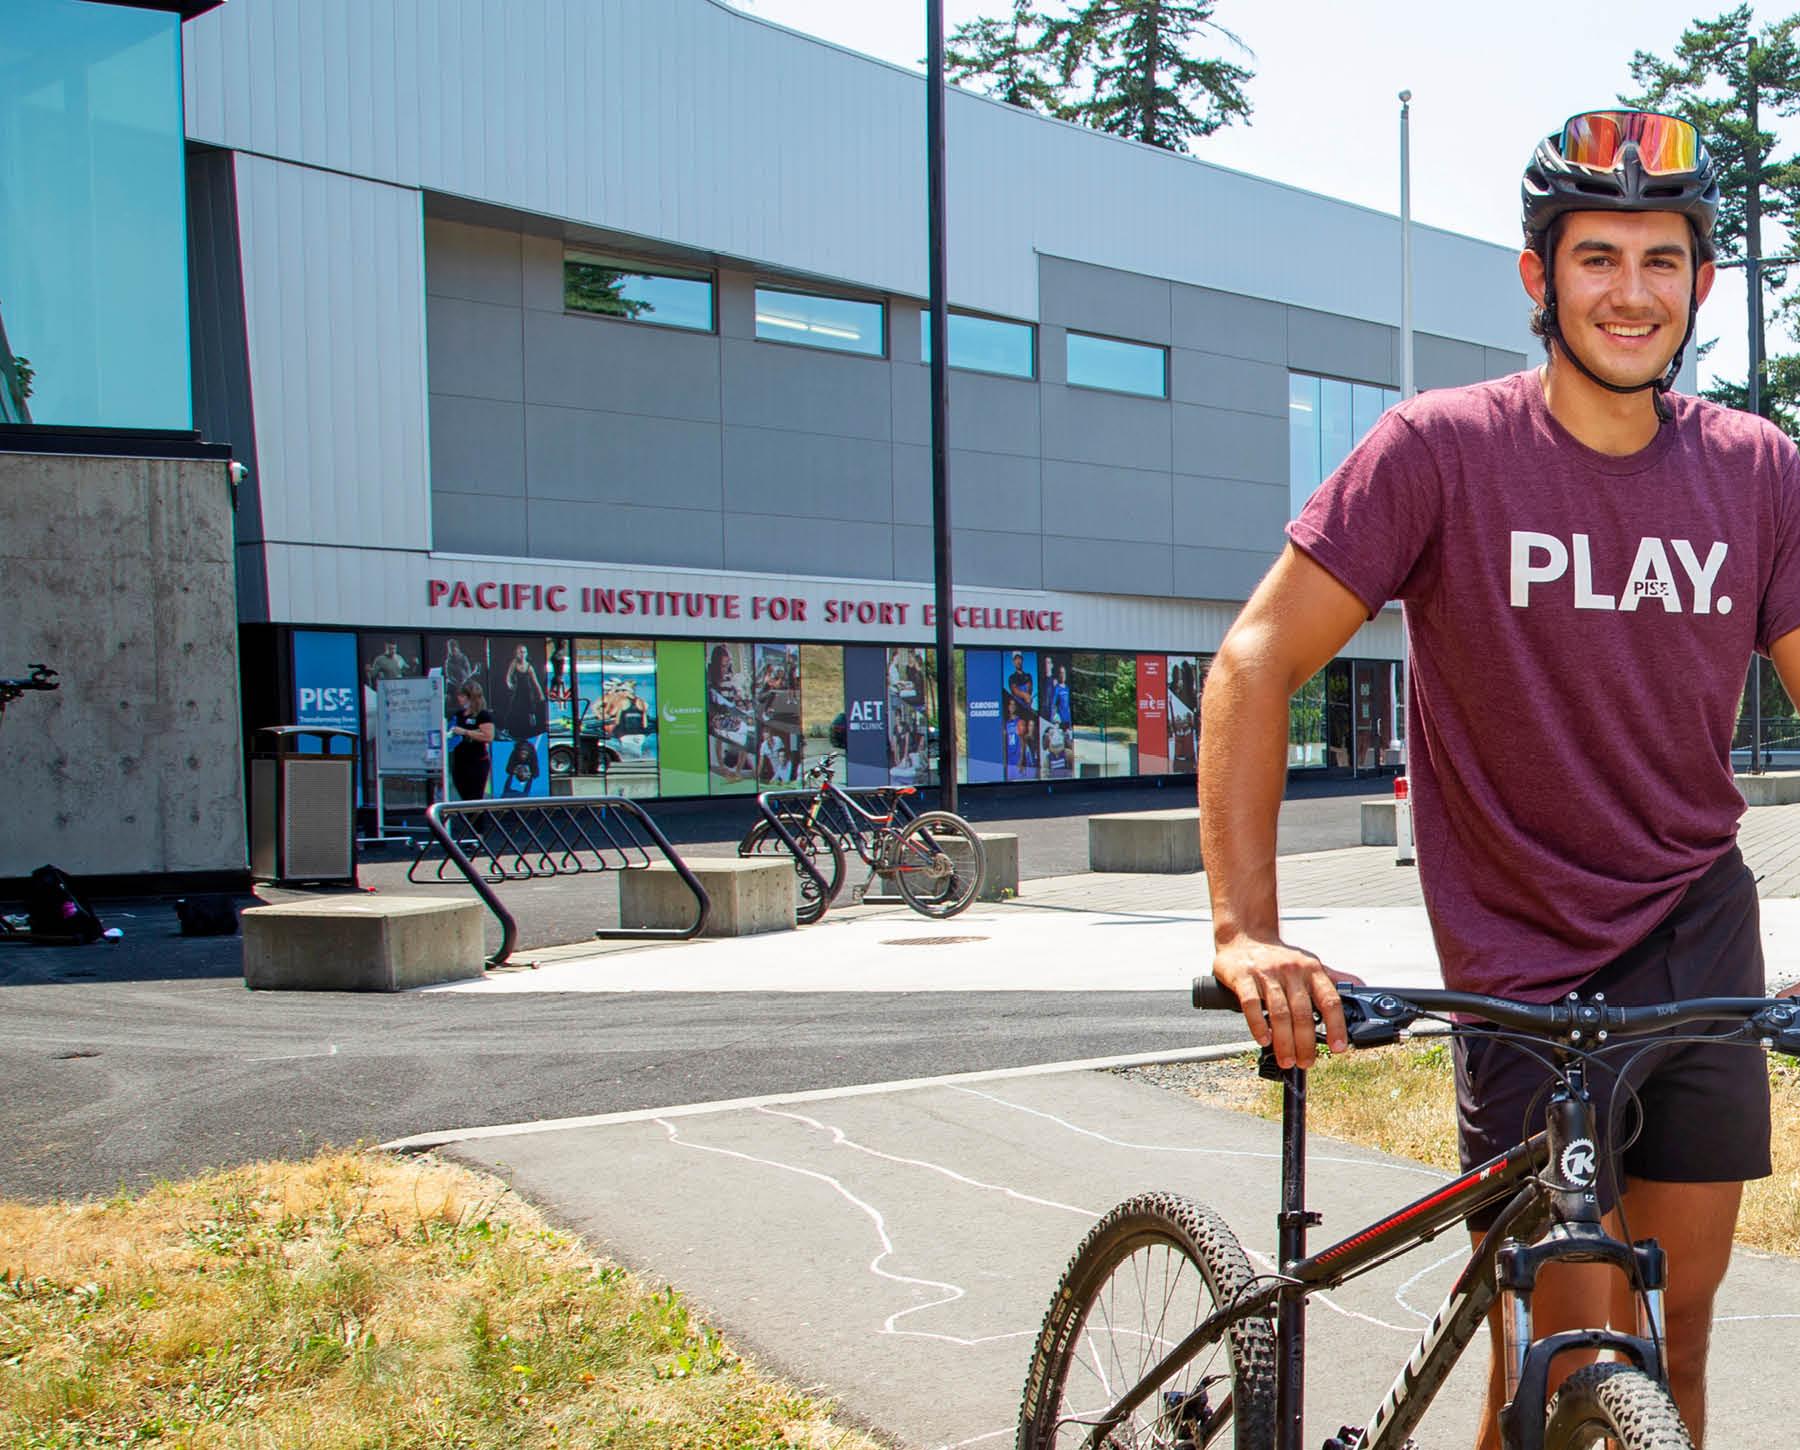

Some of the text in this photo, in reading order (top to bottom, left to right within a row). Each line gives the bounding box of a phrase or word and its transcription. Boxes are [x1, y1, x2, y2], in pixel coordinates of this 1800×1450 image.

[1510, 530, 1733, 615] PLAY.
[1633, 581, 1670, 597] PISE
[428, 578, 1064, 632] PACIFIC INSTITUTE FOR SPORT ECELLENCE
[299, 687, 355, 712] PISE
[849, 700, 884, 721] AET
[861, 722, 885, 730] CLINIC
